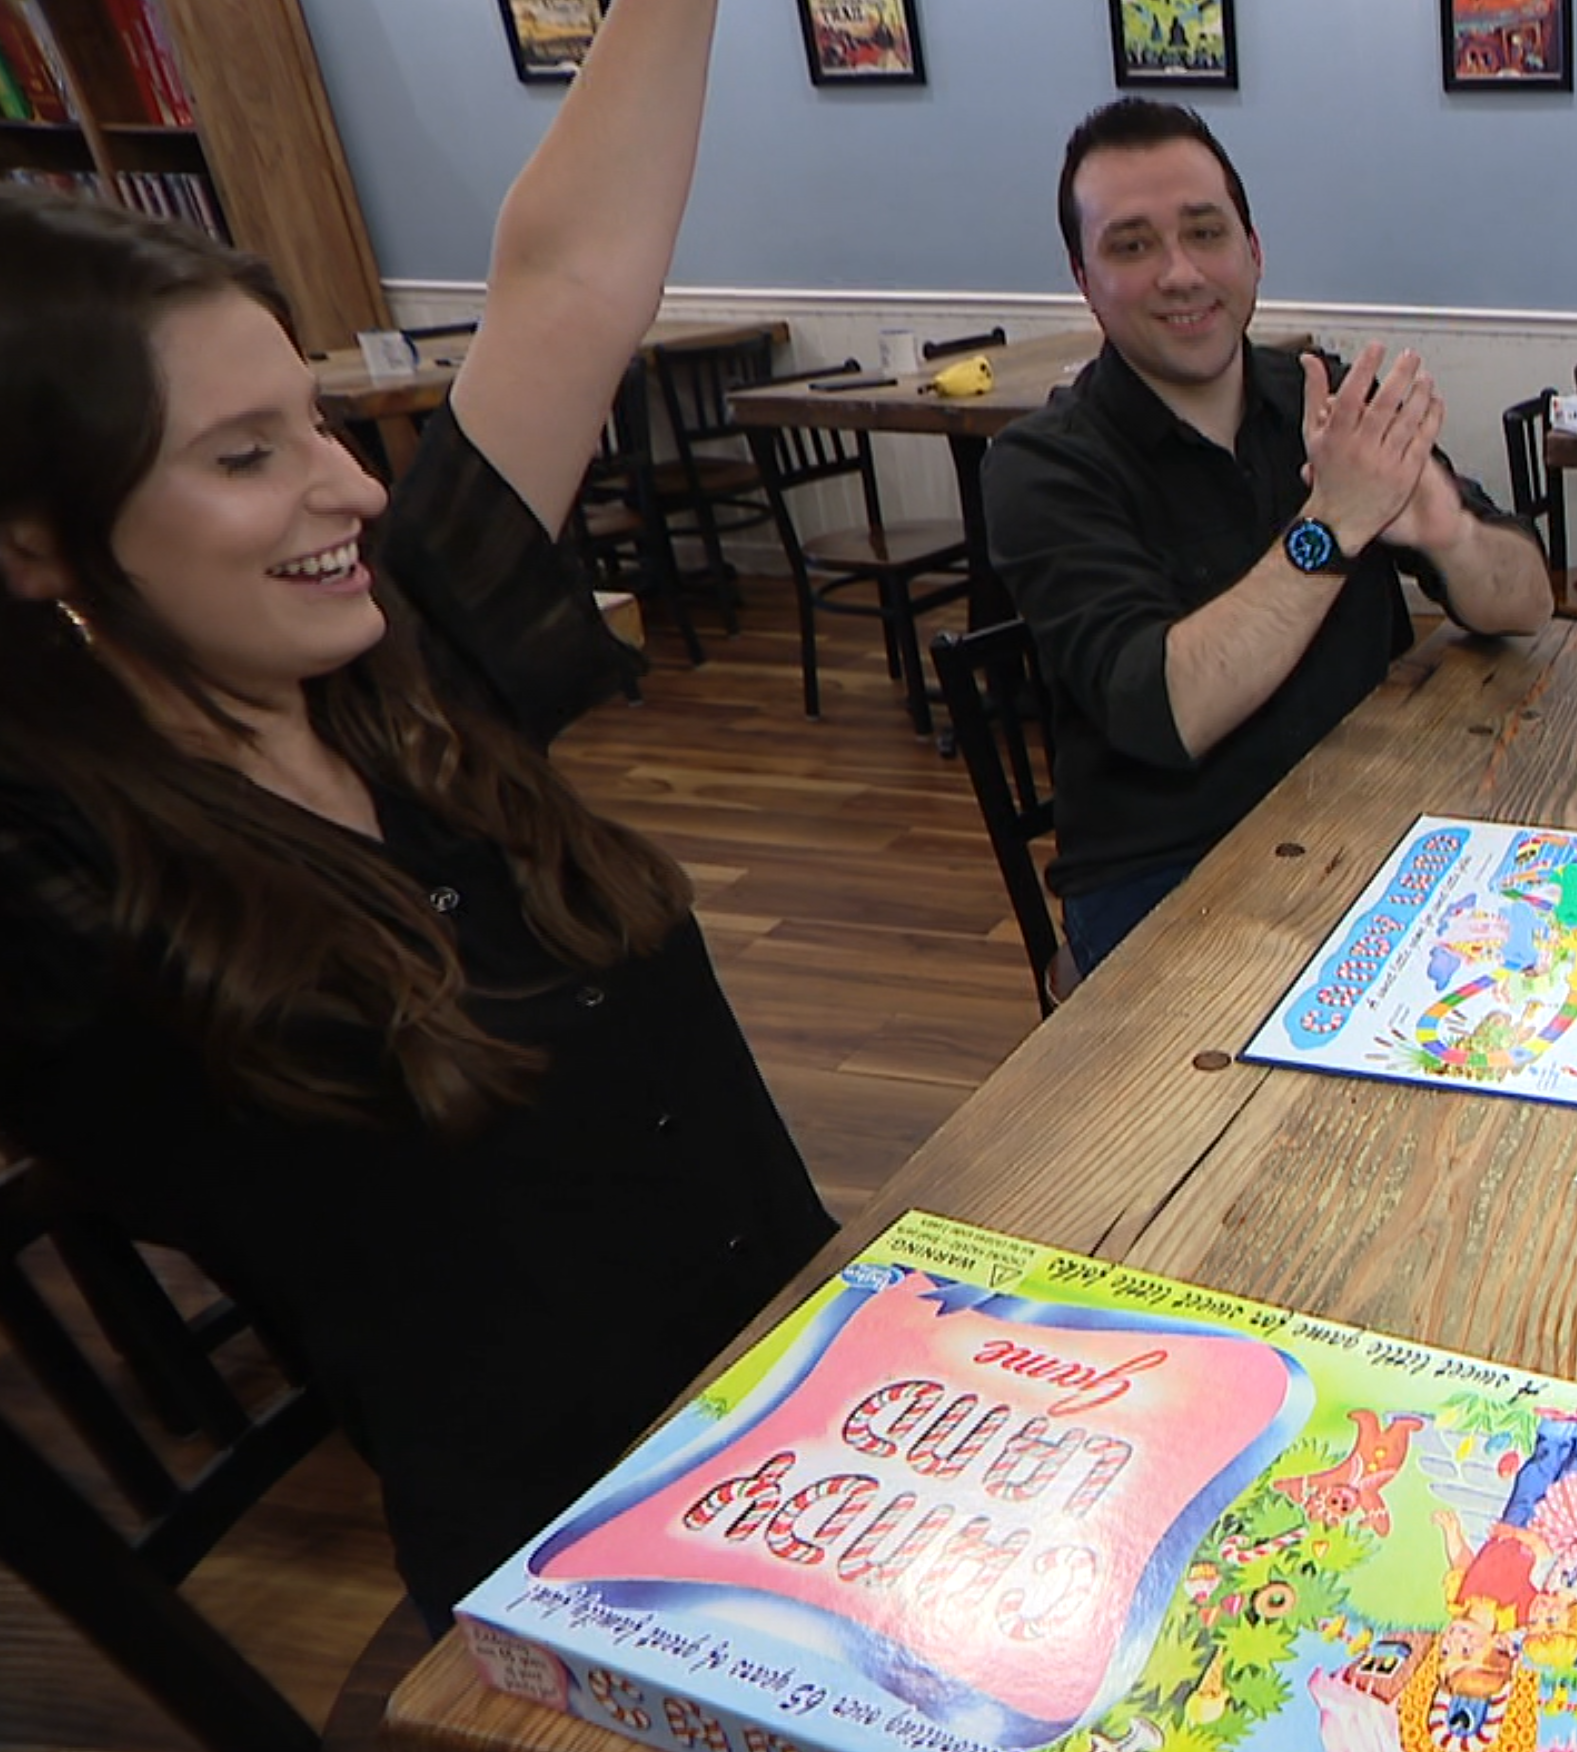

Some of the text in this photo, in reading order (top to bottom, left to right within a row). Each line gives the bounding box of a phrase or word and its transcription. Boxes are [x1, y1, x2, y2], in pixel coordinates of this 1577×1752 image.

[1049, 1256, 1549, 1405] A sweet little game for sweet little folks
[842, 1379, 1134, 1518] LAND
[682, 1450, 1098, 1642] CANDY
[636, 1626, 712, 1658] great
[729, 1659, 797, 1691] years
[779, 1684, 827, 1716] 65
[832, 1697, 881, 1725] over
